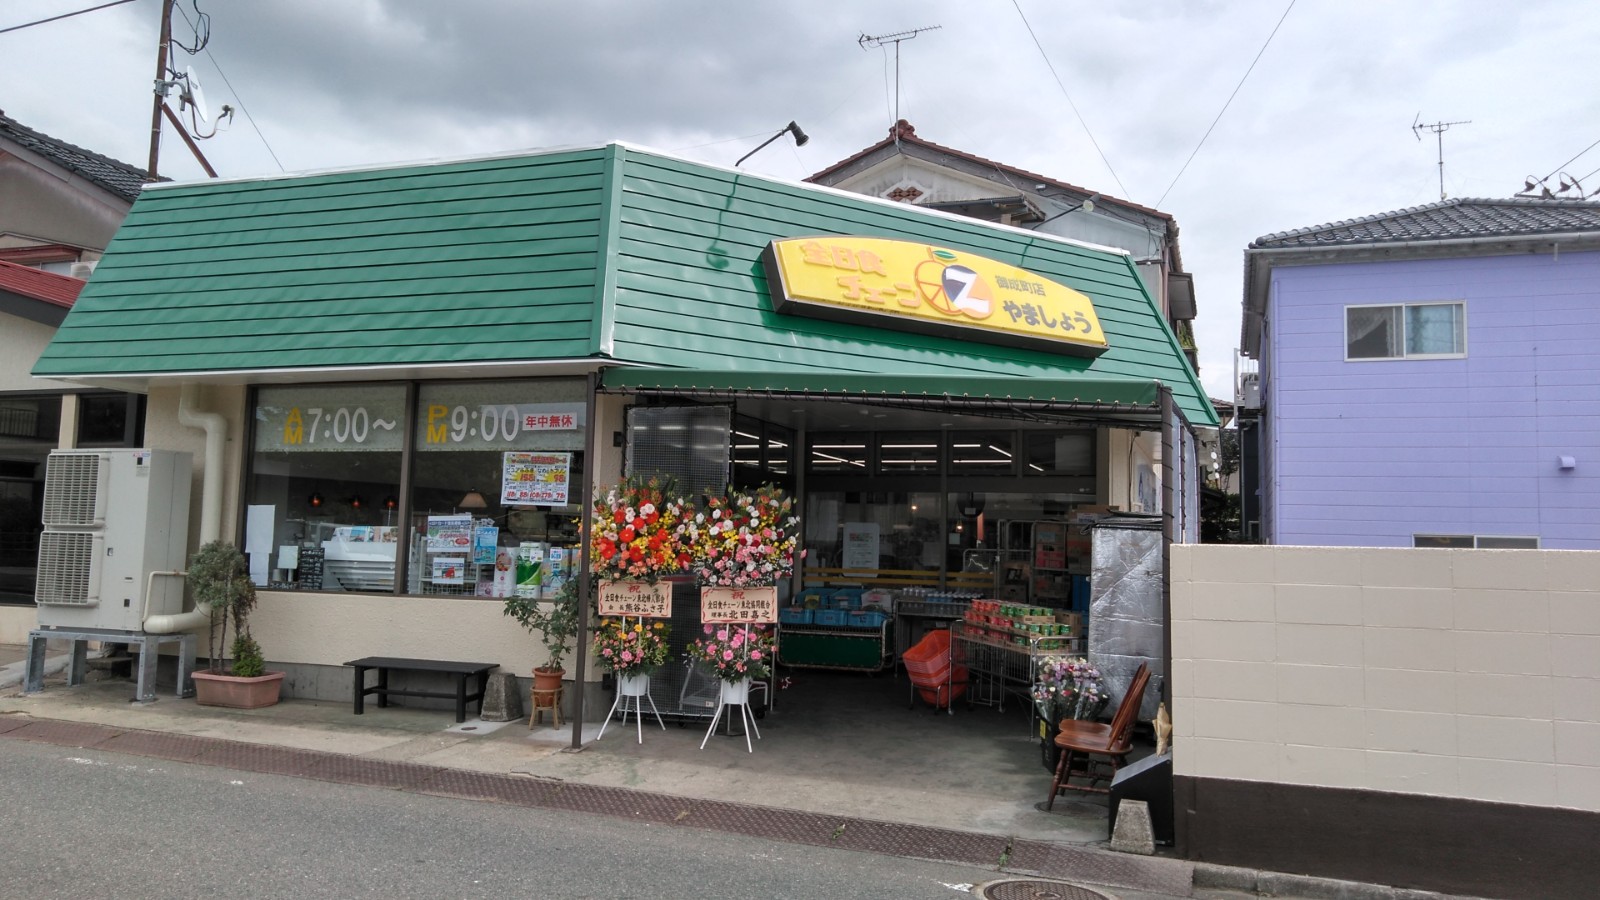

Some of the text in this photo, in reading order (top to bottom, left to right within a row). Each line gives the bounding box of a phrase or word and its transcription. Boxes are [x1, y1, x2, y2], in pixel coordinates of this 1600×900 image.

[800, 241, 887, 277] 全日食
[838, 275, 921, 308] チェーン
[995, 274, 1046, 297] 御成町店
[1002, 299, 1092, 334] やましょう
[451, 405, 519, 442] 9:00
[525, 414, 573, 429] 年中無休
[628, 584, 641, 593] 祝
[731, 591, 745, 600] 祝
[708, 600, 770, 610] 全日食チェーン東北協同組合
